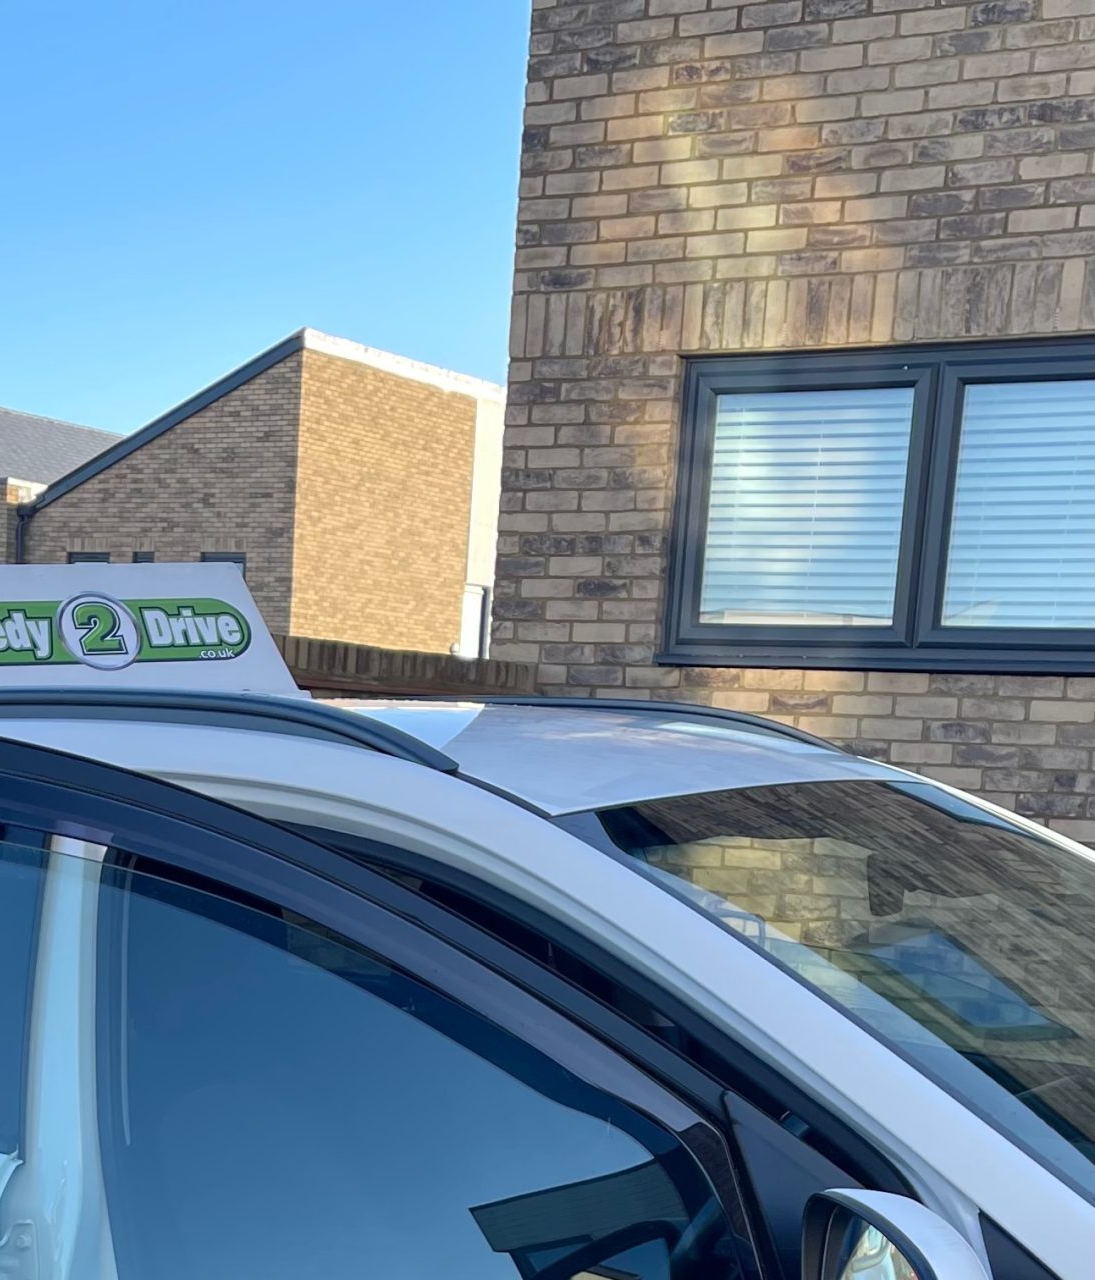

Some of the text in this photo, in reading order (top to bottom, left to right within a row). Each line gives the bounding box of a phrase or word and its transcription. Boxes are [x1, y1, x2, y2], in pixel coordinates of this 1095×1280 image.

[77, 602, 126, 655] 2
[142, 607, 240, 644] Drive
[199, 647, 235, 658] .co.uk
